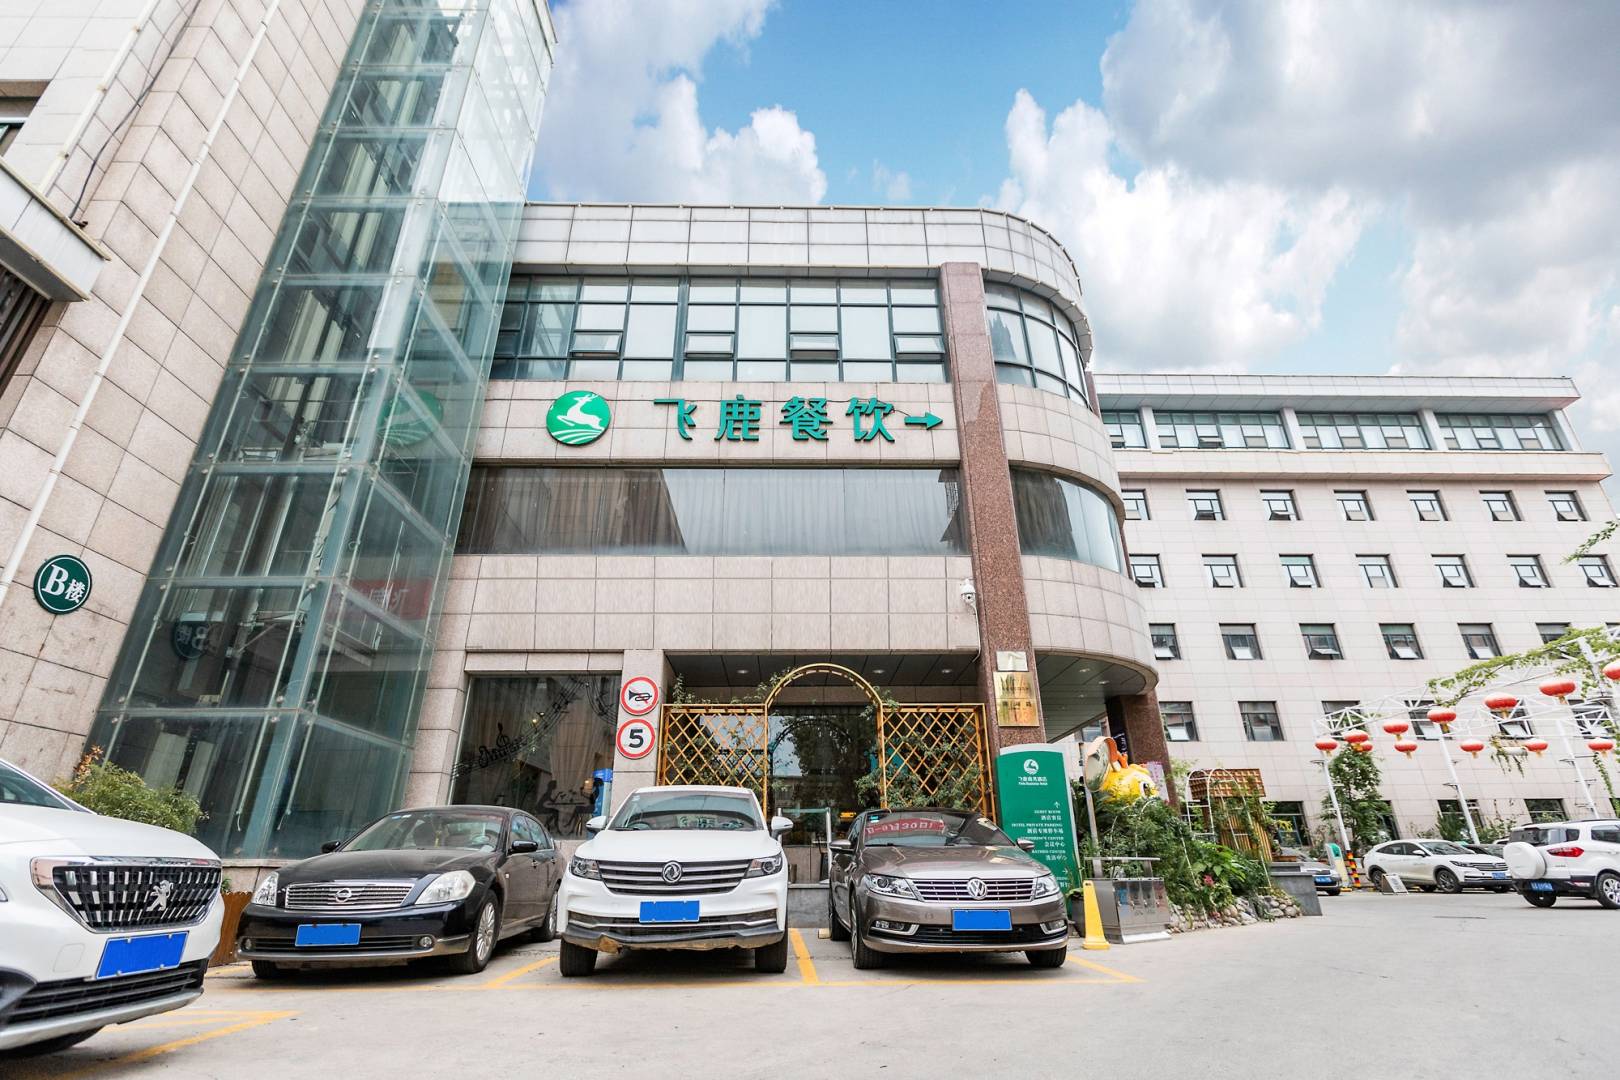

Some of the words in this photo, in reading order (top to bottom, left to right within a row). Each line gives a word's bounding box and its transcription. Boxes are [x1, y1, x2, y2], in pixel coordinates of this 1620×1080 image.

[653, 394, 895, 443] 飞鹿餐饮
[41, 564, 86, 603] B楼
[628, 728, 644, 748] 5
